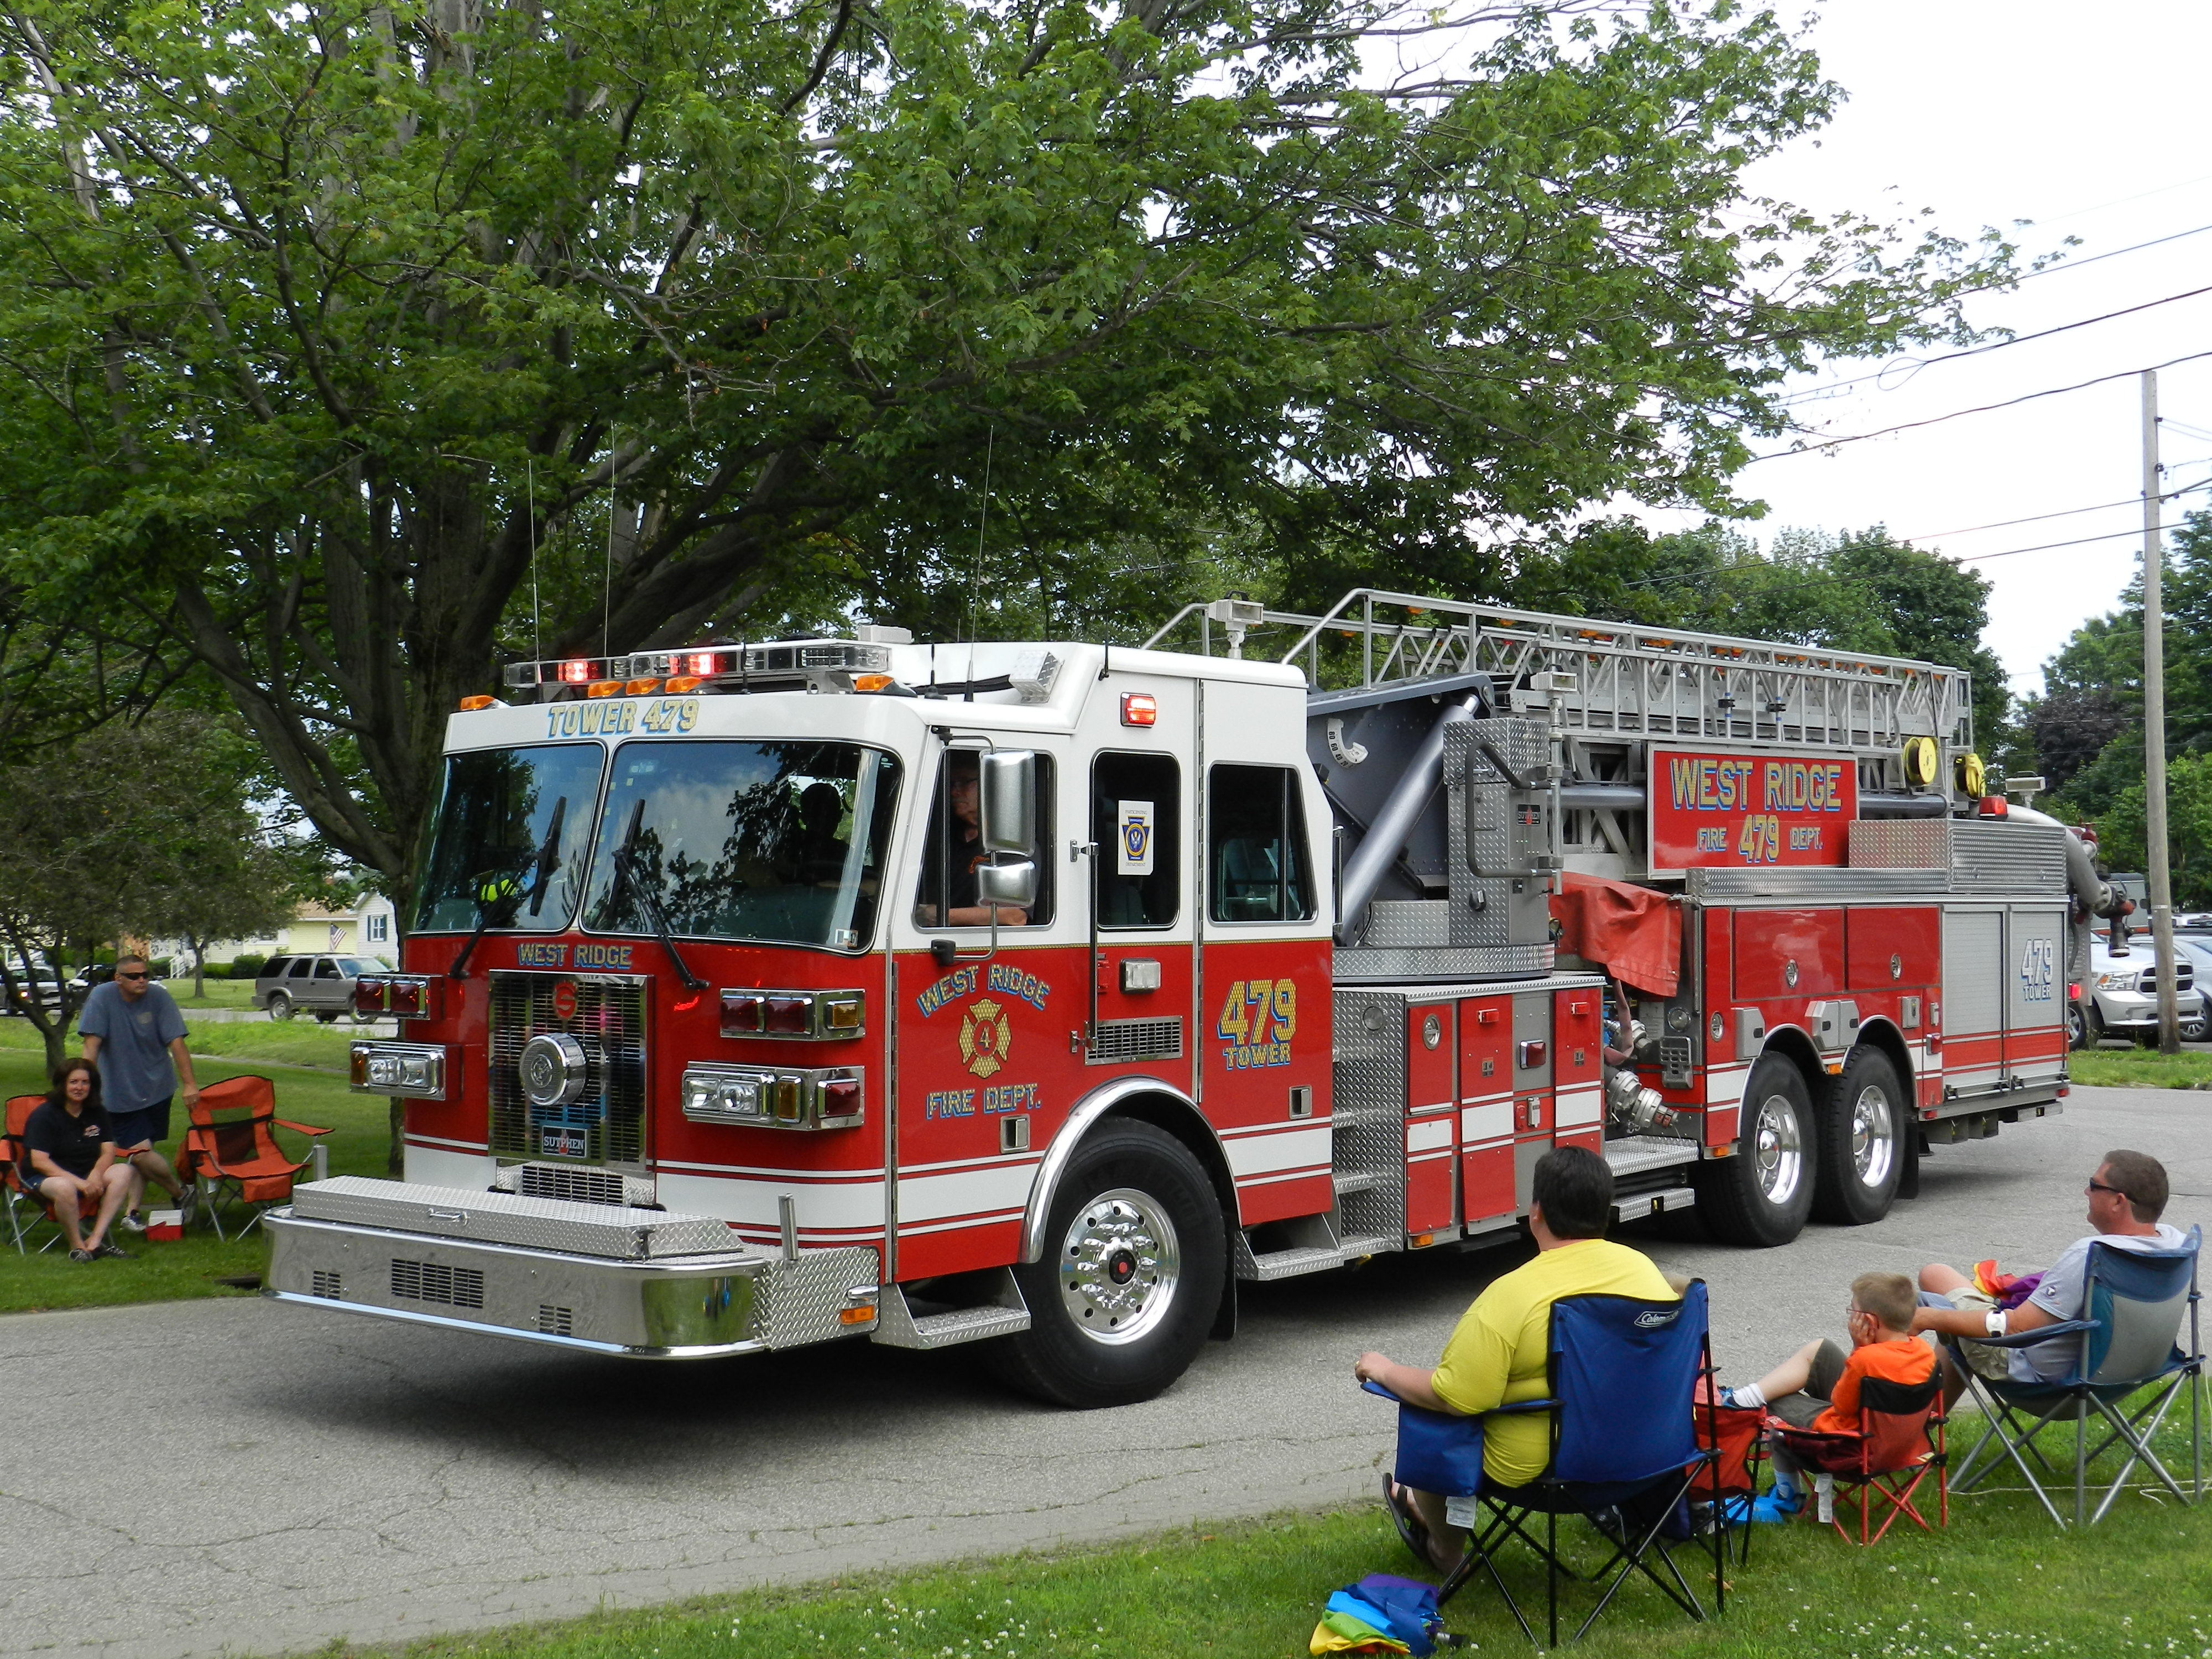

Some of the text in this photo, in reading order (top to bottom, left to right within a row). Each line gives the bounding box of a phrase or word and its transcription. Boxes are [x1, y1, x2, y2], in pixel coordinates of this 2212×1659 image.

[547, 699, 700, 738] TOWER 479
[1329, 731, 1335, 739] 80
[1670, 758, 1841, 811] WEST RIDGE
[1697, 814, 1823, 863] FIRE 479 DEPT.
[518, 943, 633, 969] WEST RIDGE
[2020, 938, 2053, 985] 479
[916, 964, 1051, 1018] WEST RIDGE
[2023, 984, 2051, 1001] TOWER
[1217, 978, 1296, 1047] 479
[978, 1026, 992, 1050] 4
[1223, 1043, 1291, 1071] TOWER
[926, 1083, 1041, 1120] FIRE DEPT.
[544, 1136, 585, 1149] SUTPHEN
